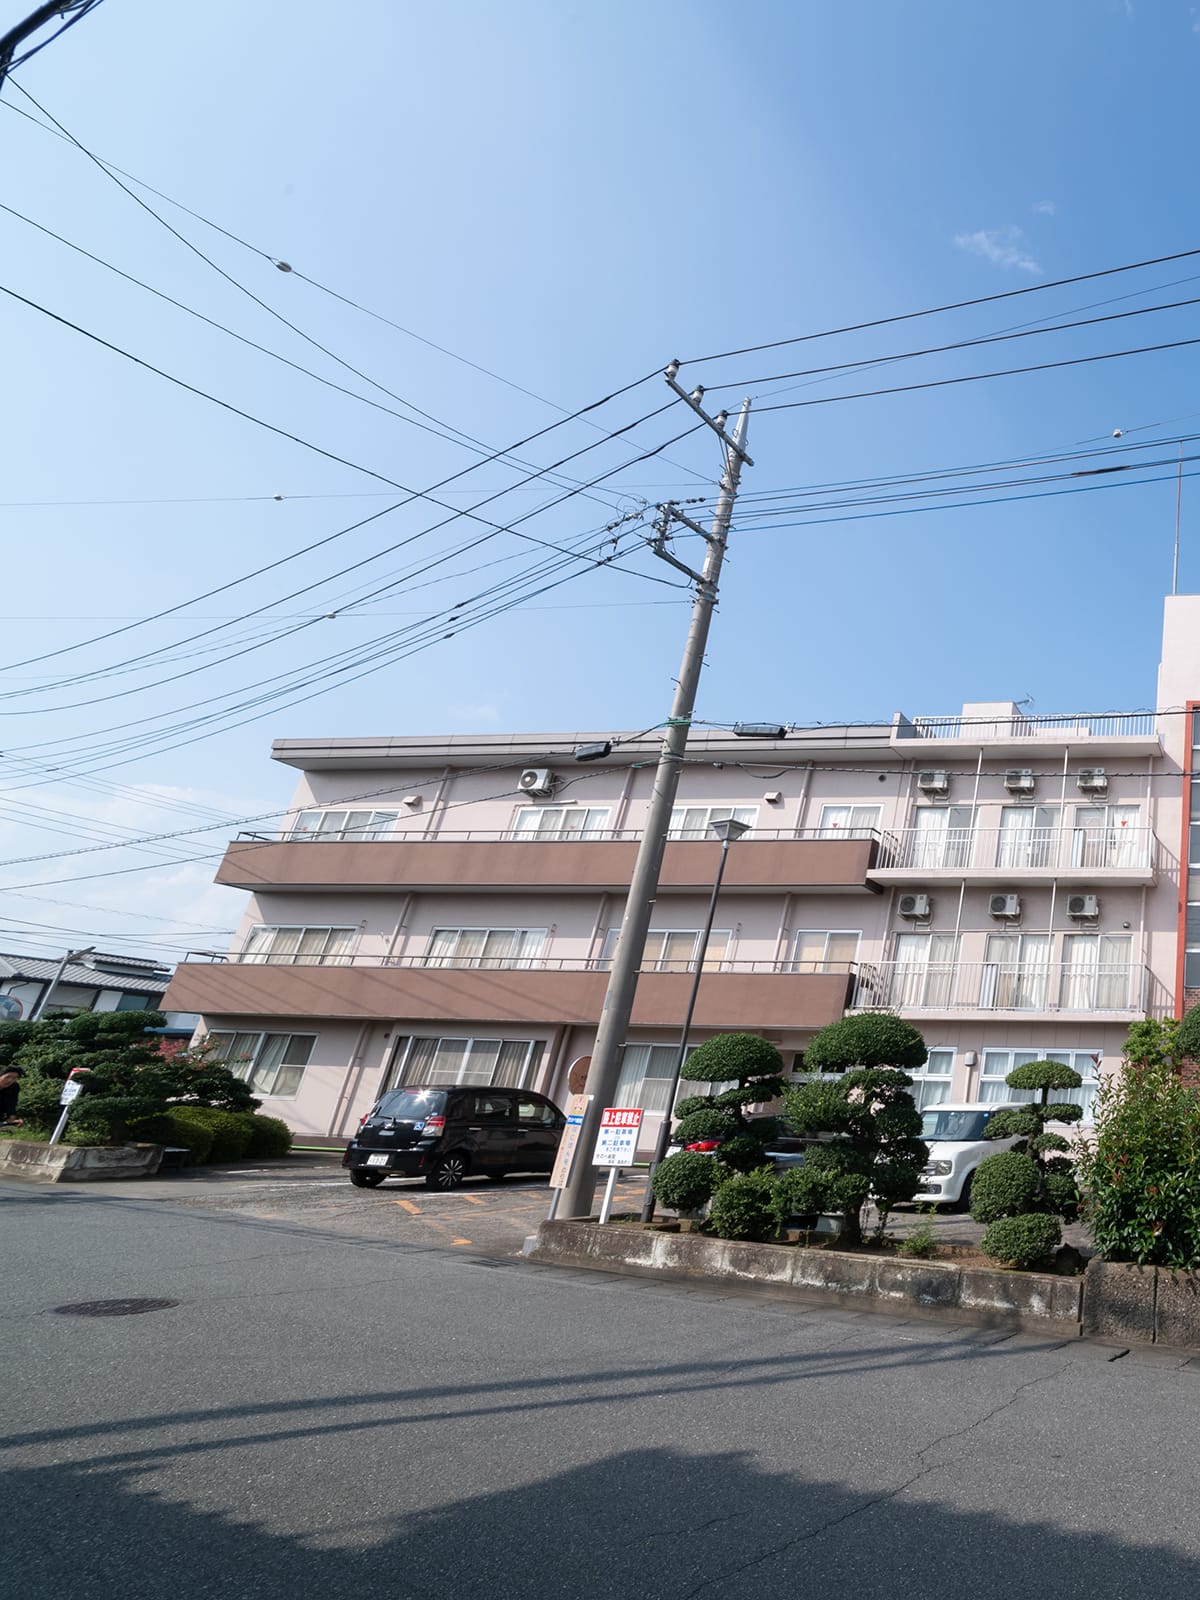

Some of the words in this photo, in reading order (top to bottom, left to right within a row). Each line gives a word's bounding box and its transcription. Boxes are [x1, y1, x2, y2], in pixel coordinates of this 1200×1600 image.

[601, 1110, 640, 1126] 路上駐車禁止
